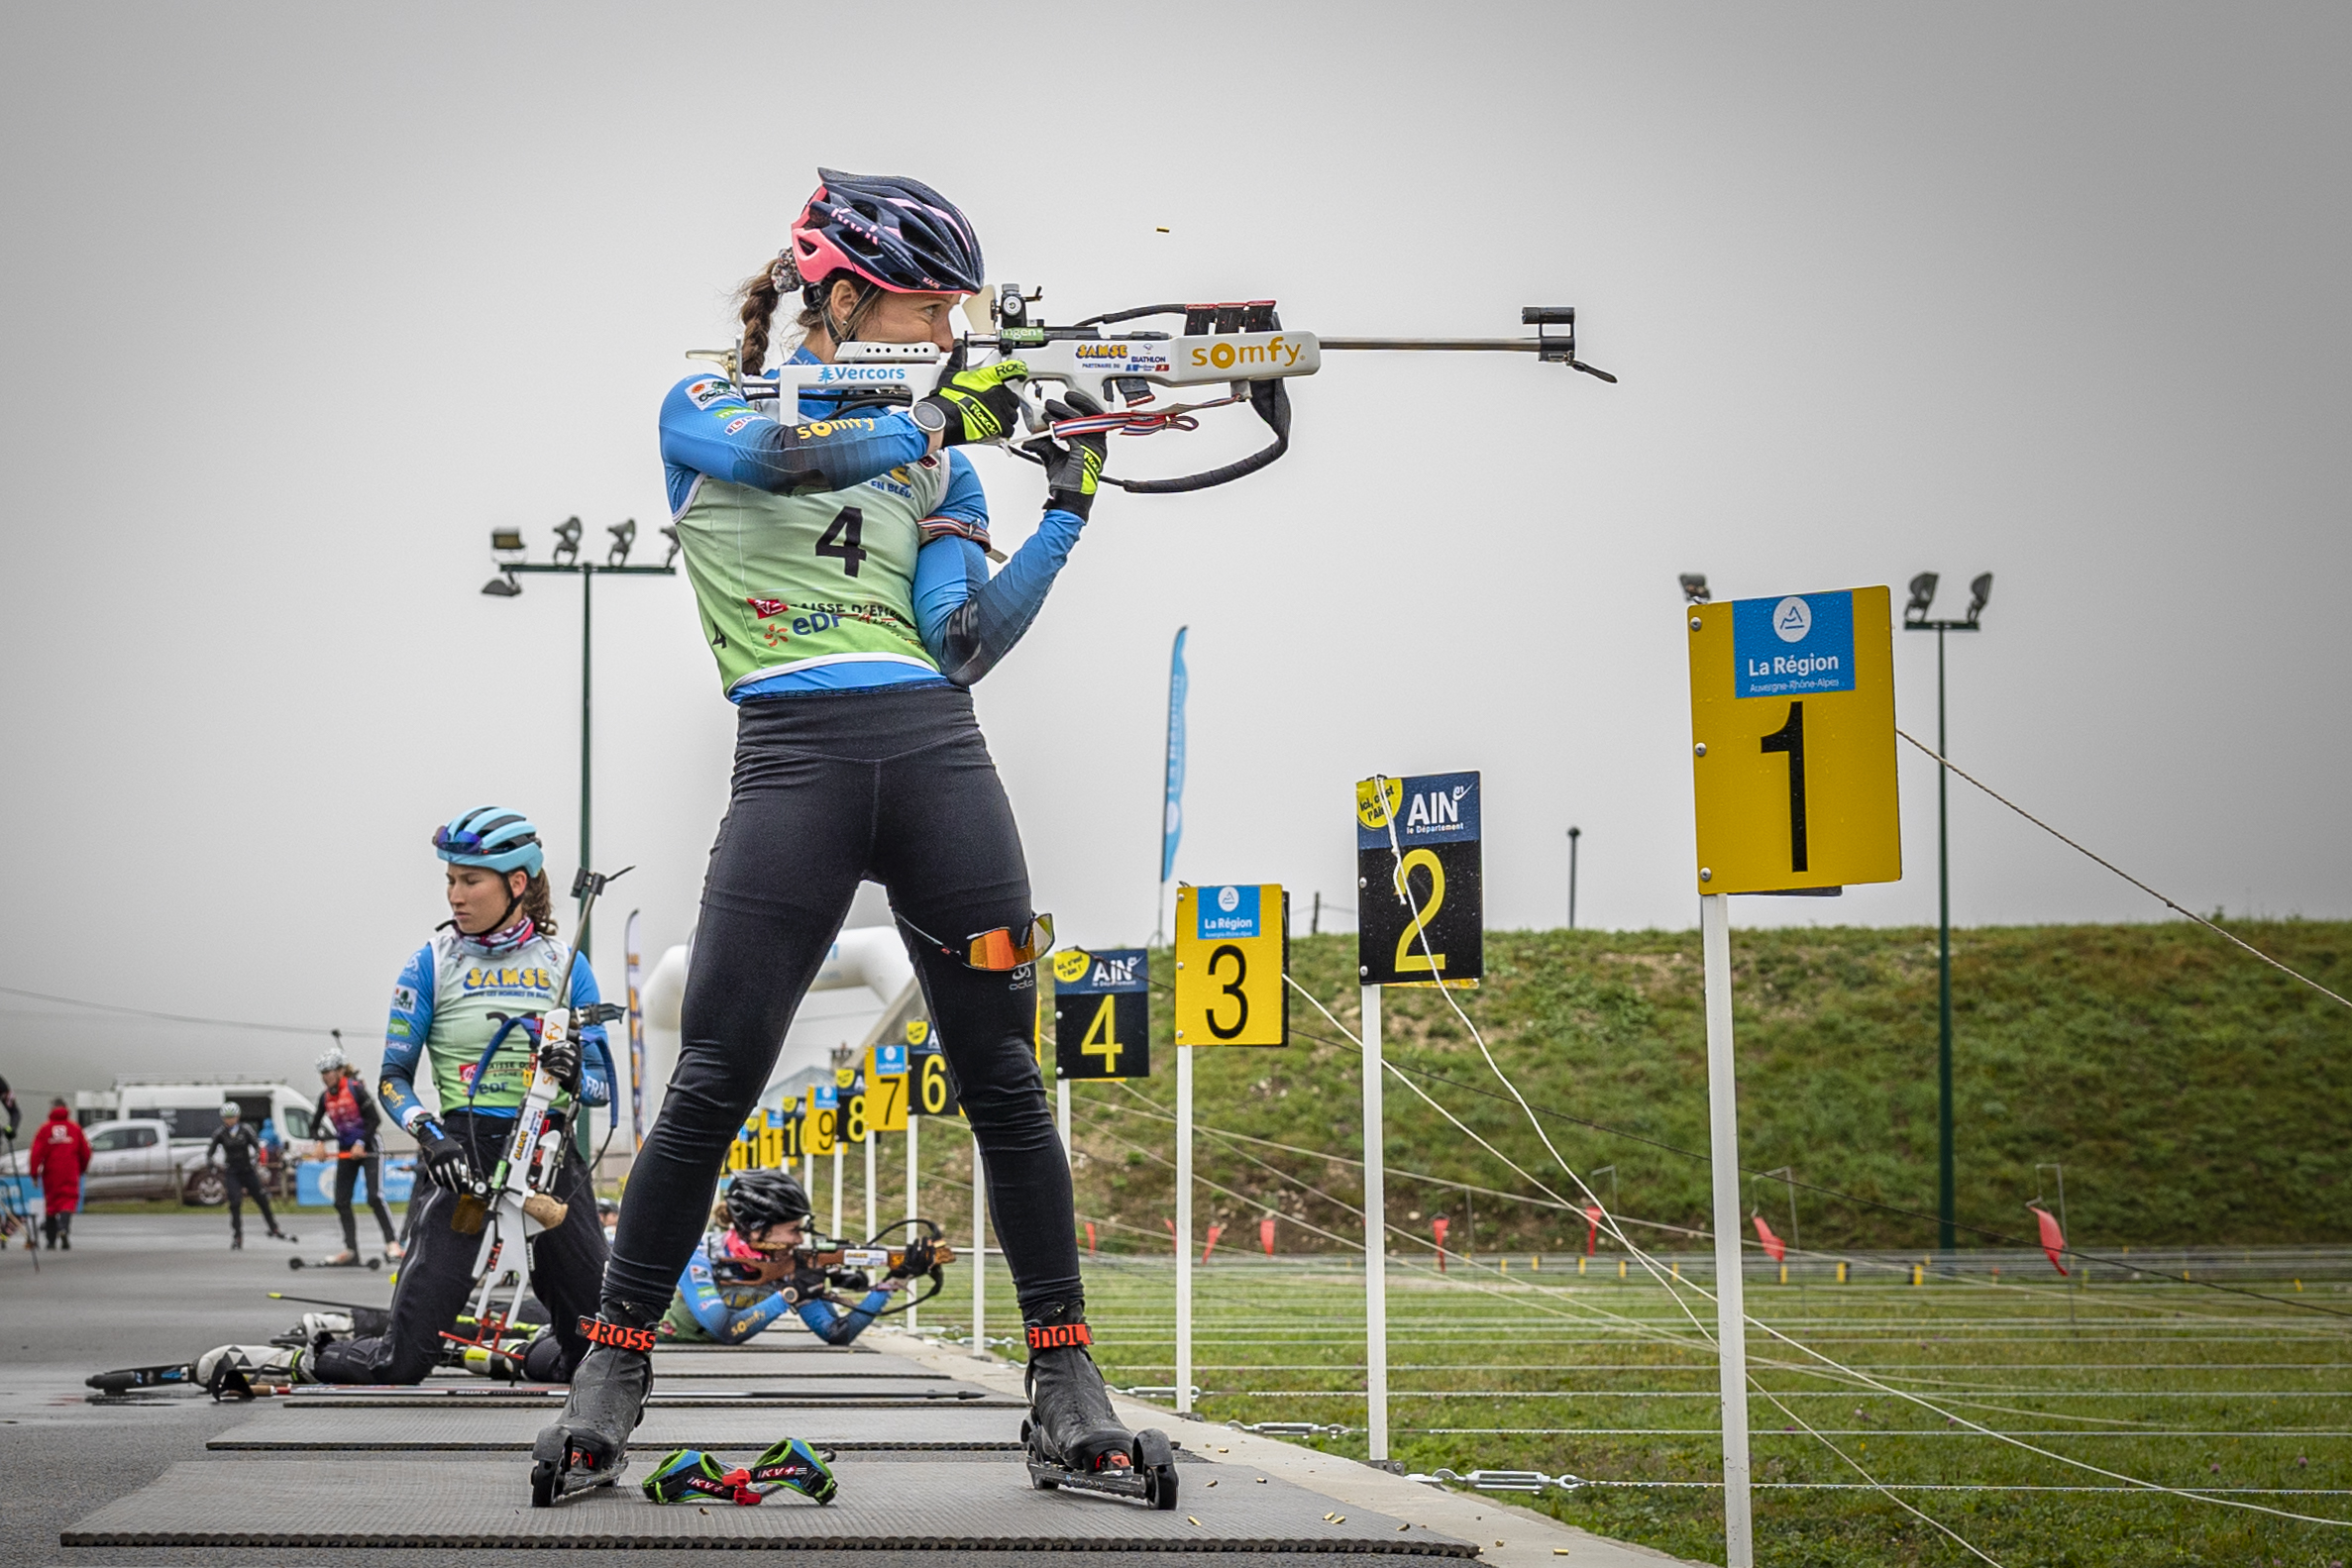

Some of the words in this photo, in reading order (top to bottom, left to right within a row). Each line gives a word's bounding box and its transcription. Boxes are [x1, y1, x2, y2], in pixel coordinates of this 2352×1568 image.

[1076, 344, 1127, 359] SAMSE
[1192, 336, 1303, 369] somfy
[834, 366, 906, 380] Vercors
[797, 417, 875, 439] somfy
[815, 505, 867, 578] 4
[1749, 658, 1770, 677] La
[1772, 653, 1839, 678] Région
[1750, 678, 1840, 693] Auvergne-Rhône-Alpes
[1761, 700, 1809, 874] 1
[1407, 791, 1458, 826] AIN
[1407, 826, 1415, 835] le
[1416, 823, 1464, 834] Département
[1204, 917, 1217, 929] La
[1218, 916, 1253, 931] Région
[1395, 848, 1446, 974] 2
[463, 967, 551, 991] SAMSE
[1205, 944, 1249, 1040] 3
[1080, 993, 1123, 1074] 4
[921, 1053, 947, 1113] 6
[879, 1077, 901, 1126] 7
[818, 1110, 835, 1151] 9
[847, 1095, 866, 1143] 8
[597, 1323, 657, 1351] ROSS
